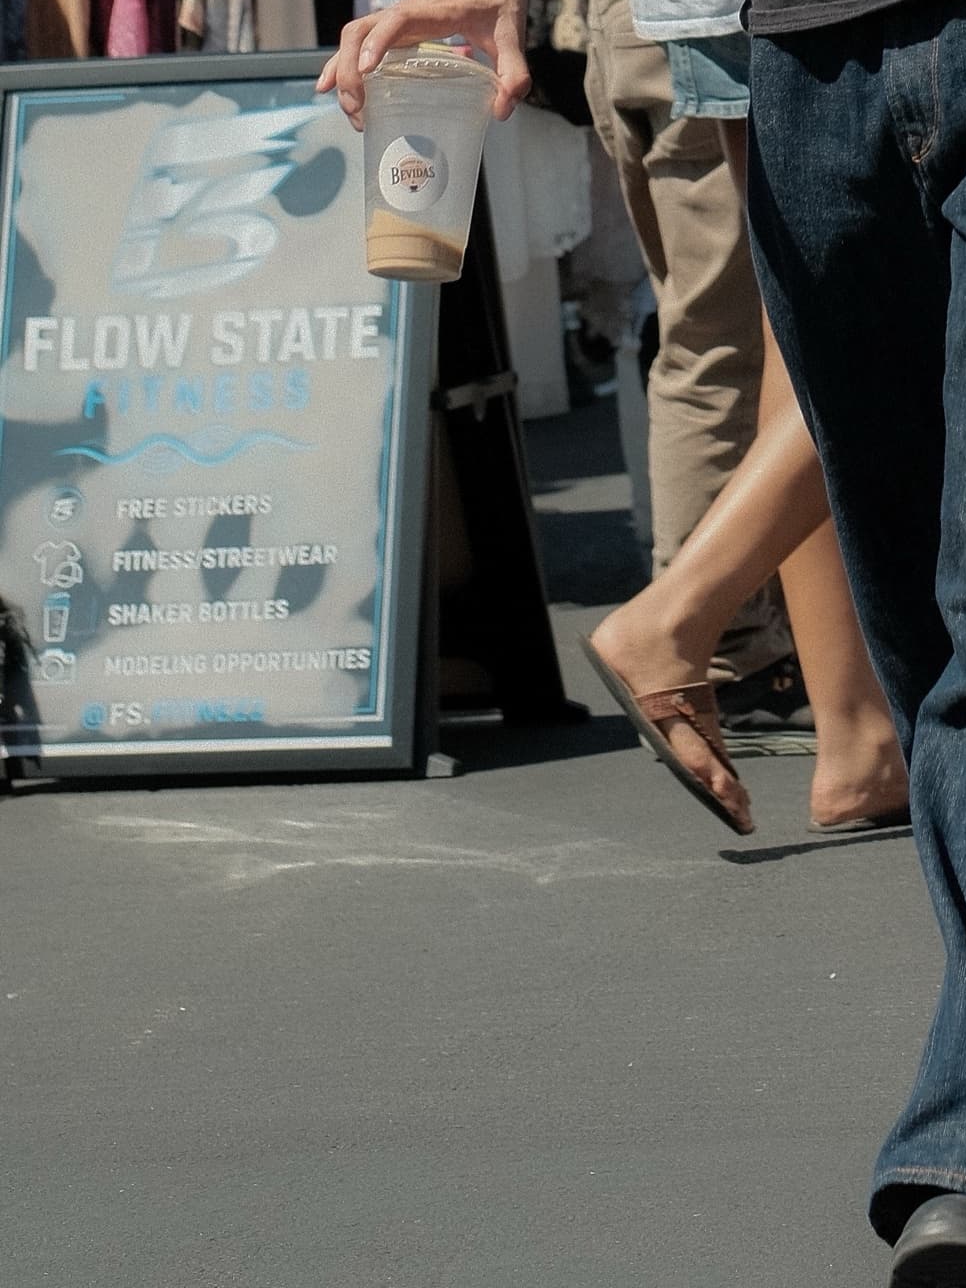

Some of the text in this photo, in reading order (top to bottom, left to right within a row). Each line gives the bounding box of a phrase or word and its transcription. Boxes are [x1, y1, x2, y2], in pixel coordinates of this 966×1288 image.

[391, 166, 436, 185] BEVIDAS
[23, 302, 383, 372] FLOW STATE
[83, 369, 312, 418] FITNESS
[115, 494, 274, 519] FREE STICKERS
[107, 598, 291, 627] SHAKER BOTTLES
[103, 647, 372, 677] MODELING OPPORTUNITIES
